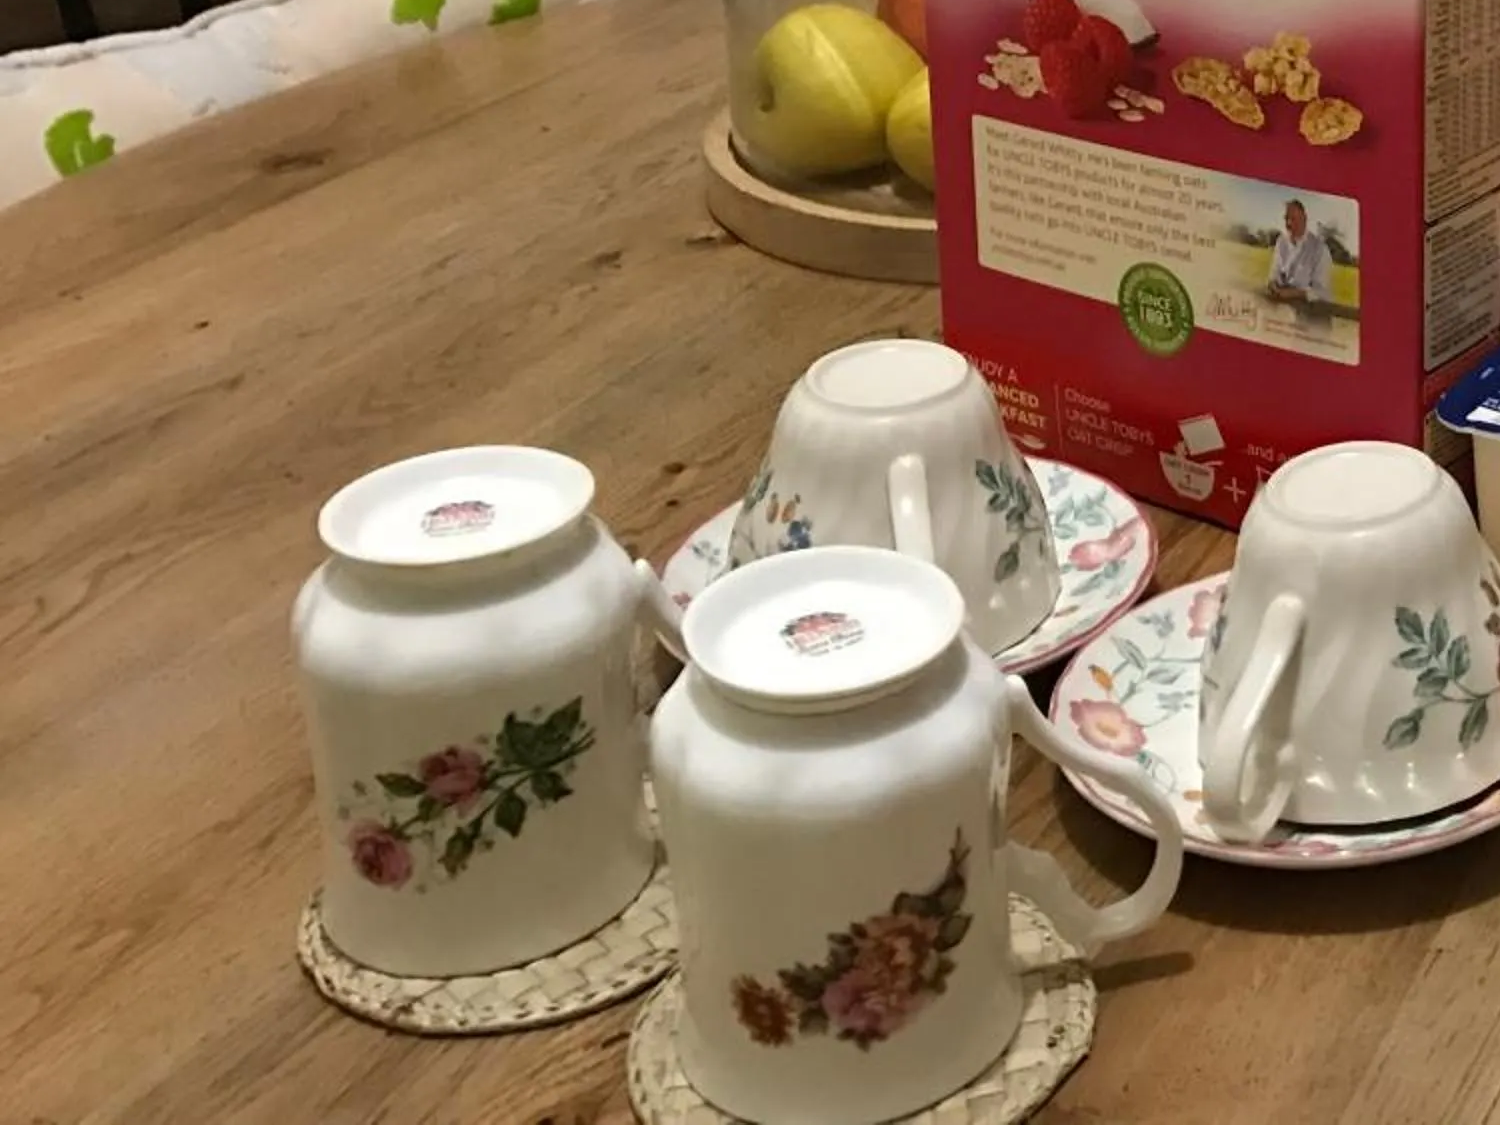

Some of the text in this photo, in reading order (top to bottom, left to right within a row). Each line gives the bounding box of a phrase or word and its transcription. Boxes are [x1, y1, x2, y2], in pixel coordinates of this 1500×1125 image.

[1006, 368, 1019, 383] A
[1064, 387, 1111, 411] Choose
[1066, 408, 1155, 445] UNCLE TOBYS
